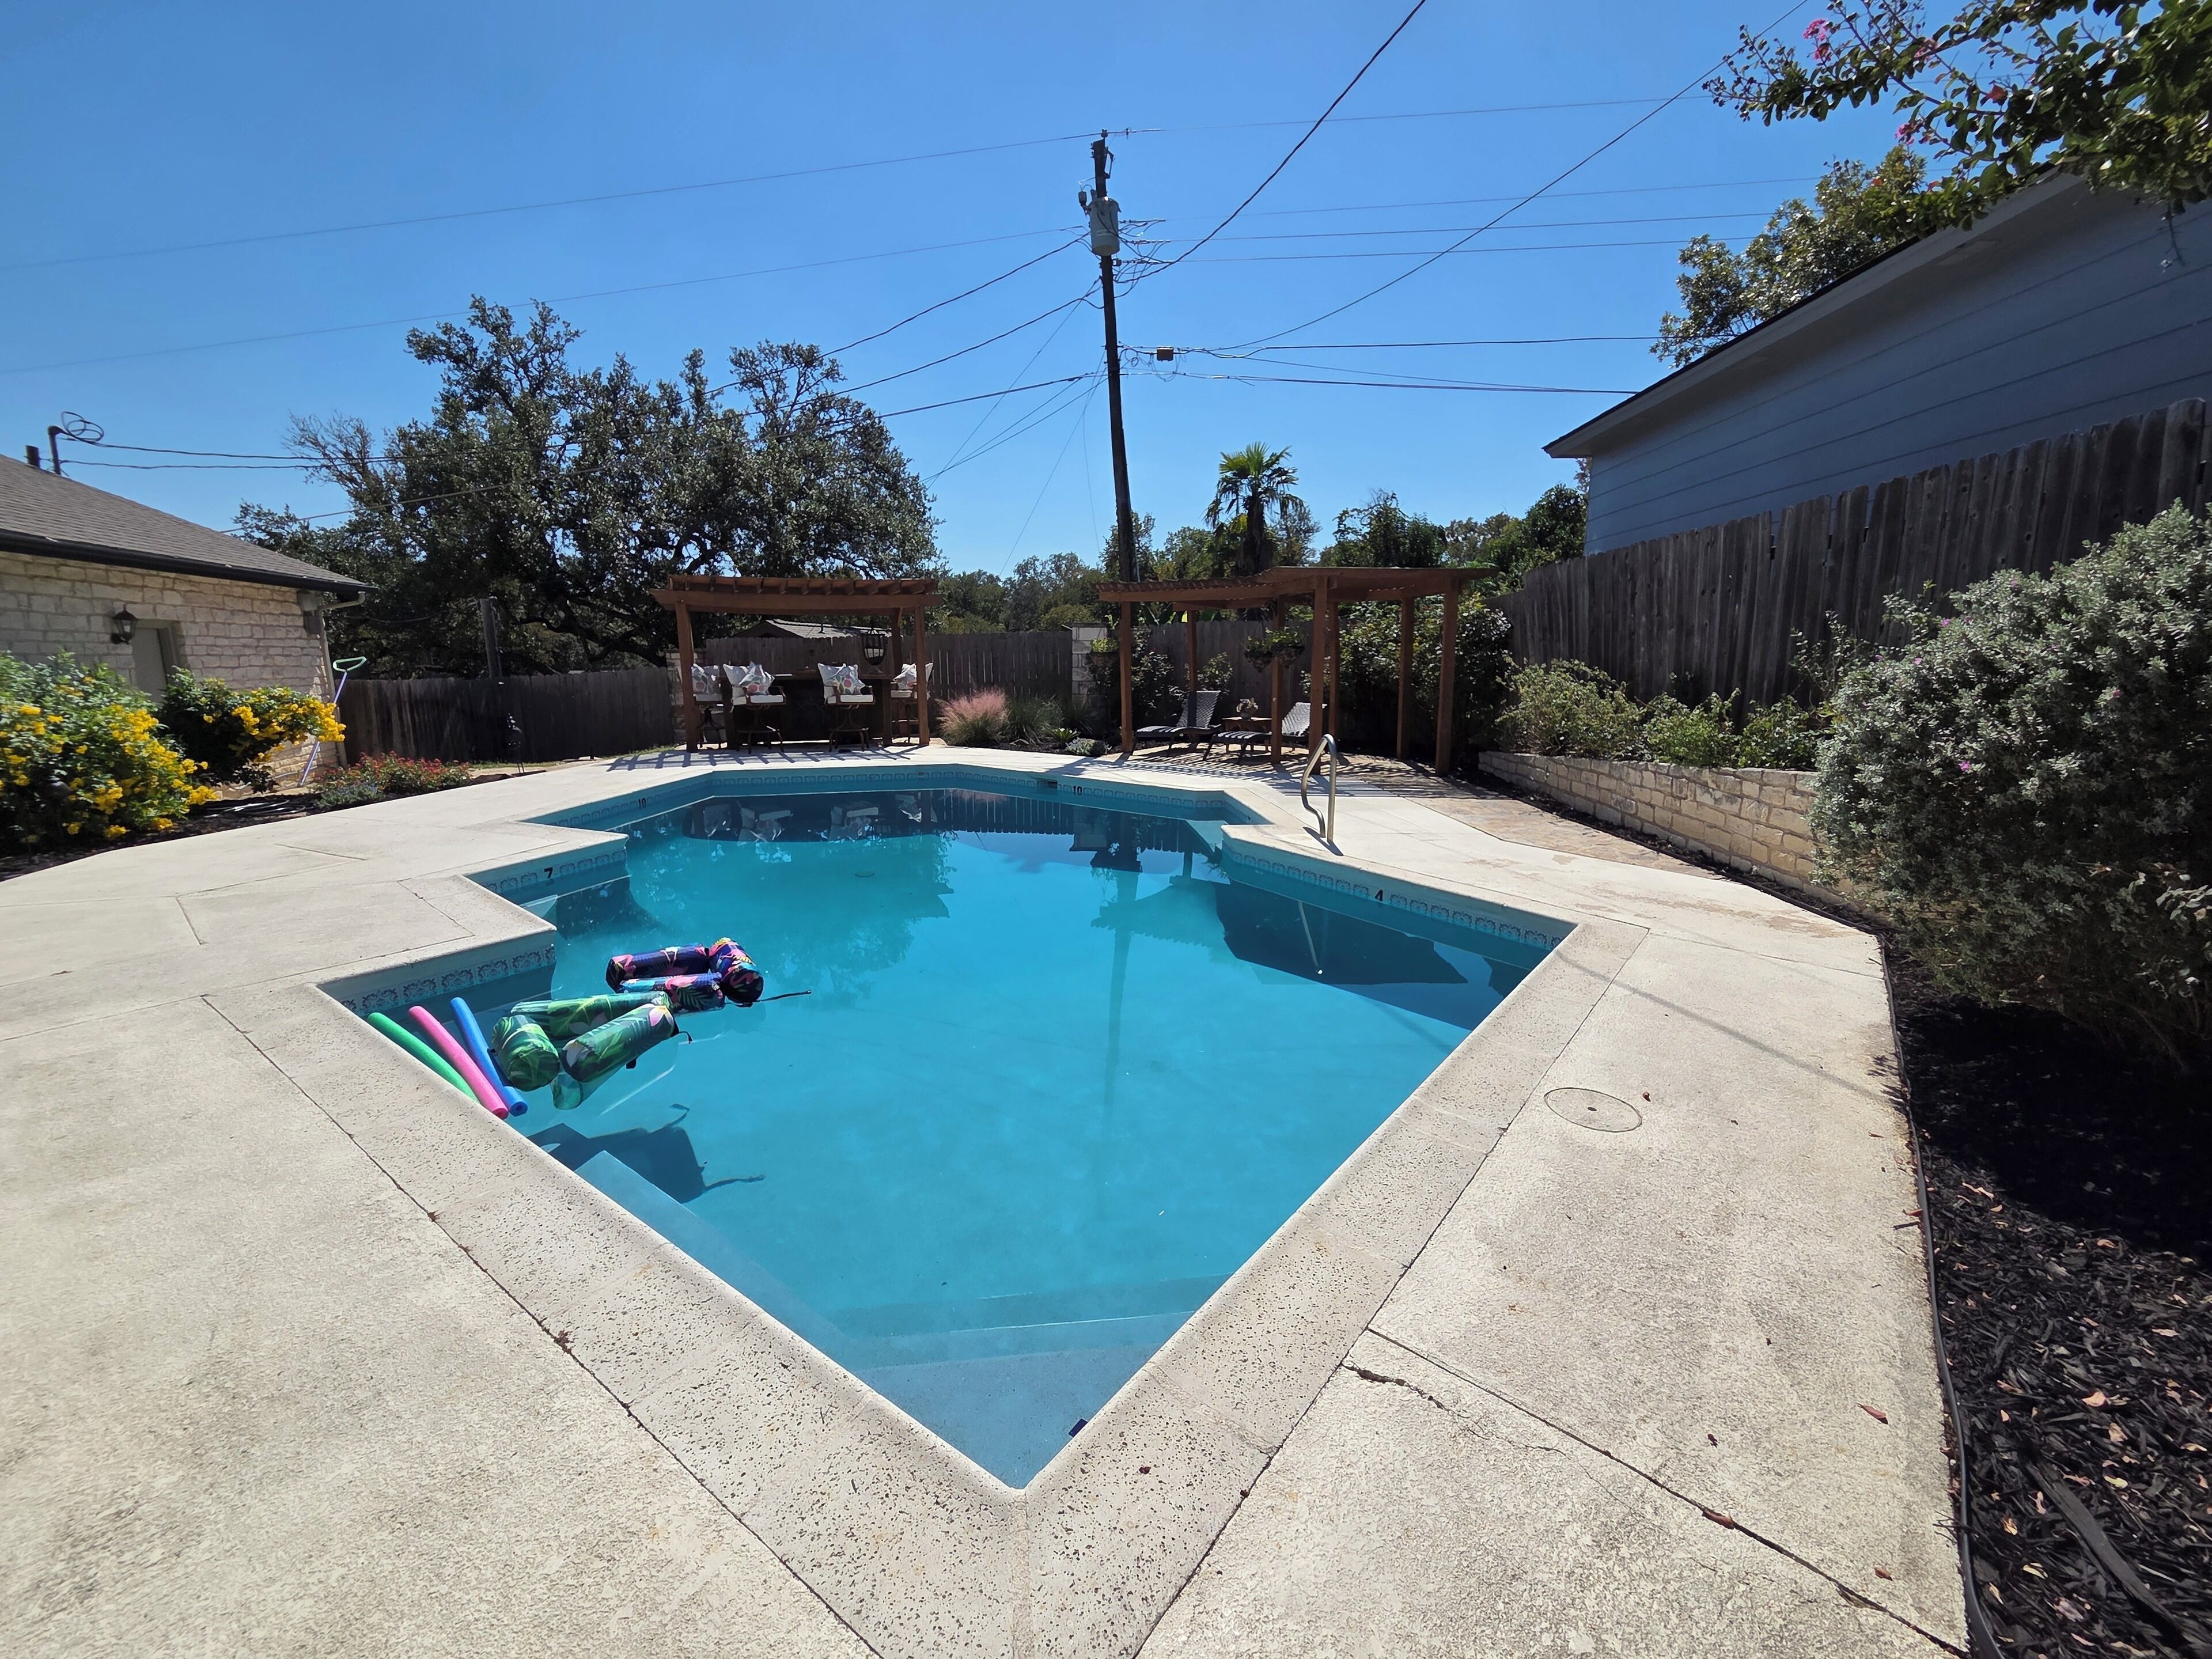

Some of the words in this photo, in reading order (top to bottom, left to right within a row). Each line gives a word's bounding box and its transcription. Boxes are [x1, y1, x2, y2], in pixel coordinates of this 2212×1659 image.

[1073, 785, 1082, 796] 10
[638, 798, 646, 809] 10
[544, 867, 553, 878] 7
[1374, 889, 1383, 902] 4
